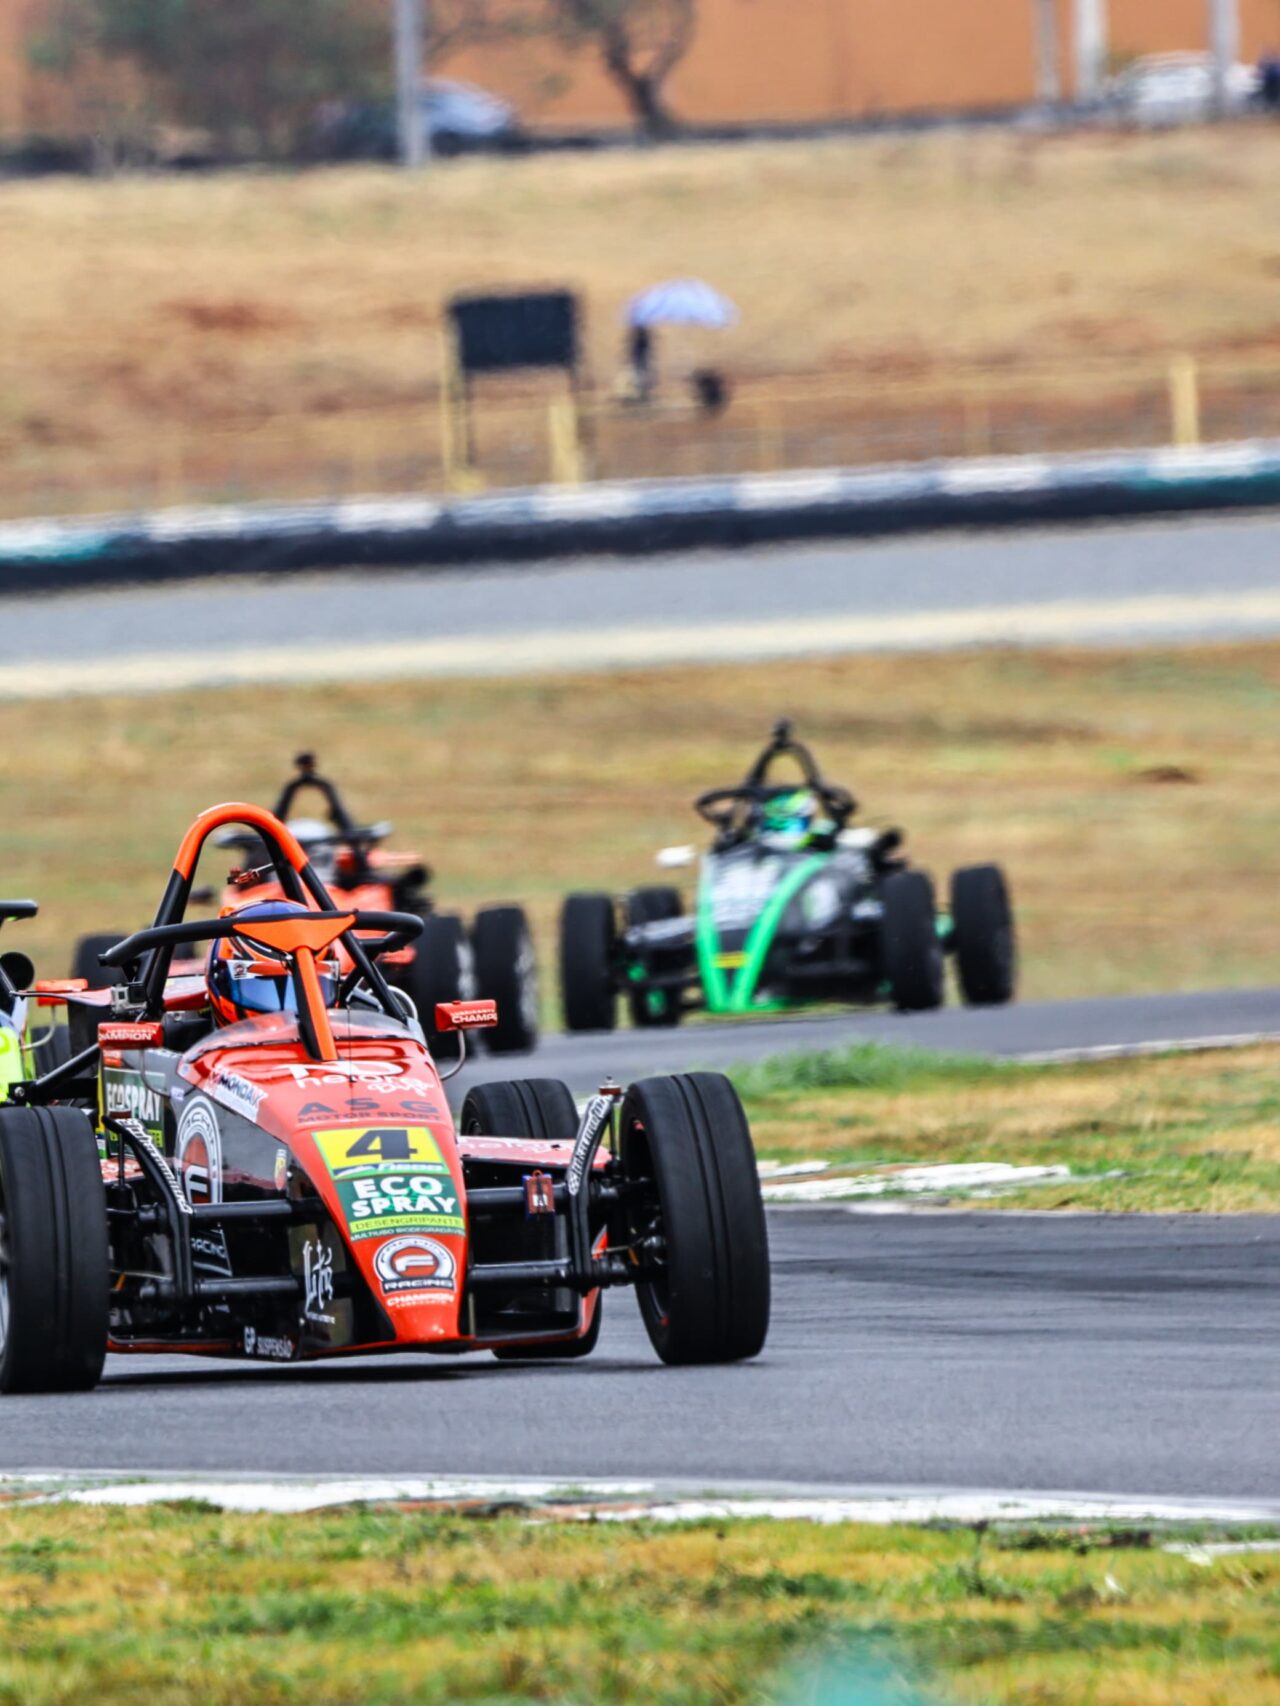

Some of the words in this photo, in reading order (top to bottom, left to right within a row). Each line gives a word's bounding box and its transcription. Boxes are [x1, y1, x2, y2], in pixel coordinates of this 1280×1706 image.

[297, 1112, 372, 1124] MOTOR
[377, 1111, 441, 1121] SPORT
[346, 1129, 418, 1160] 4
[352, 1175, 444, 1200] ECO
[351, 1196, 457, 1218] SPRAY
[354, 1216, 463, 1231] DESENGRIPANTE
[384, 1281, 454, 1291] RACING
